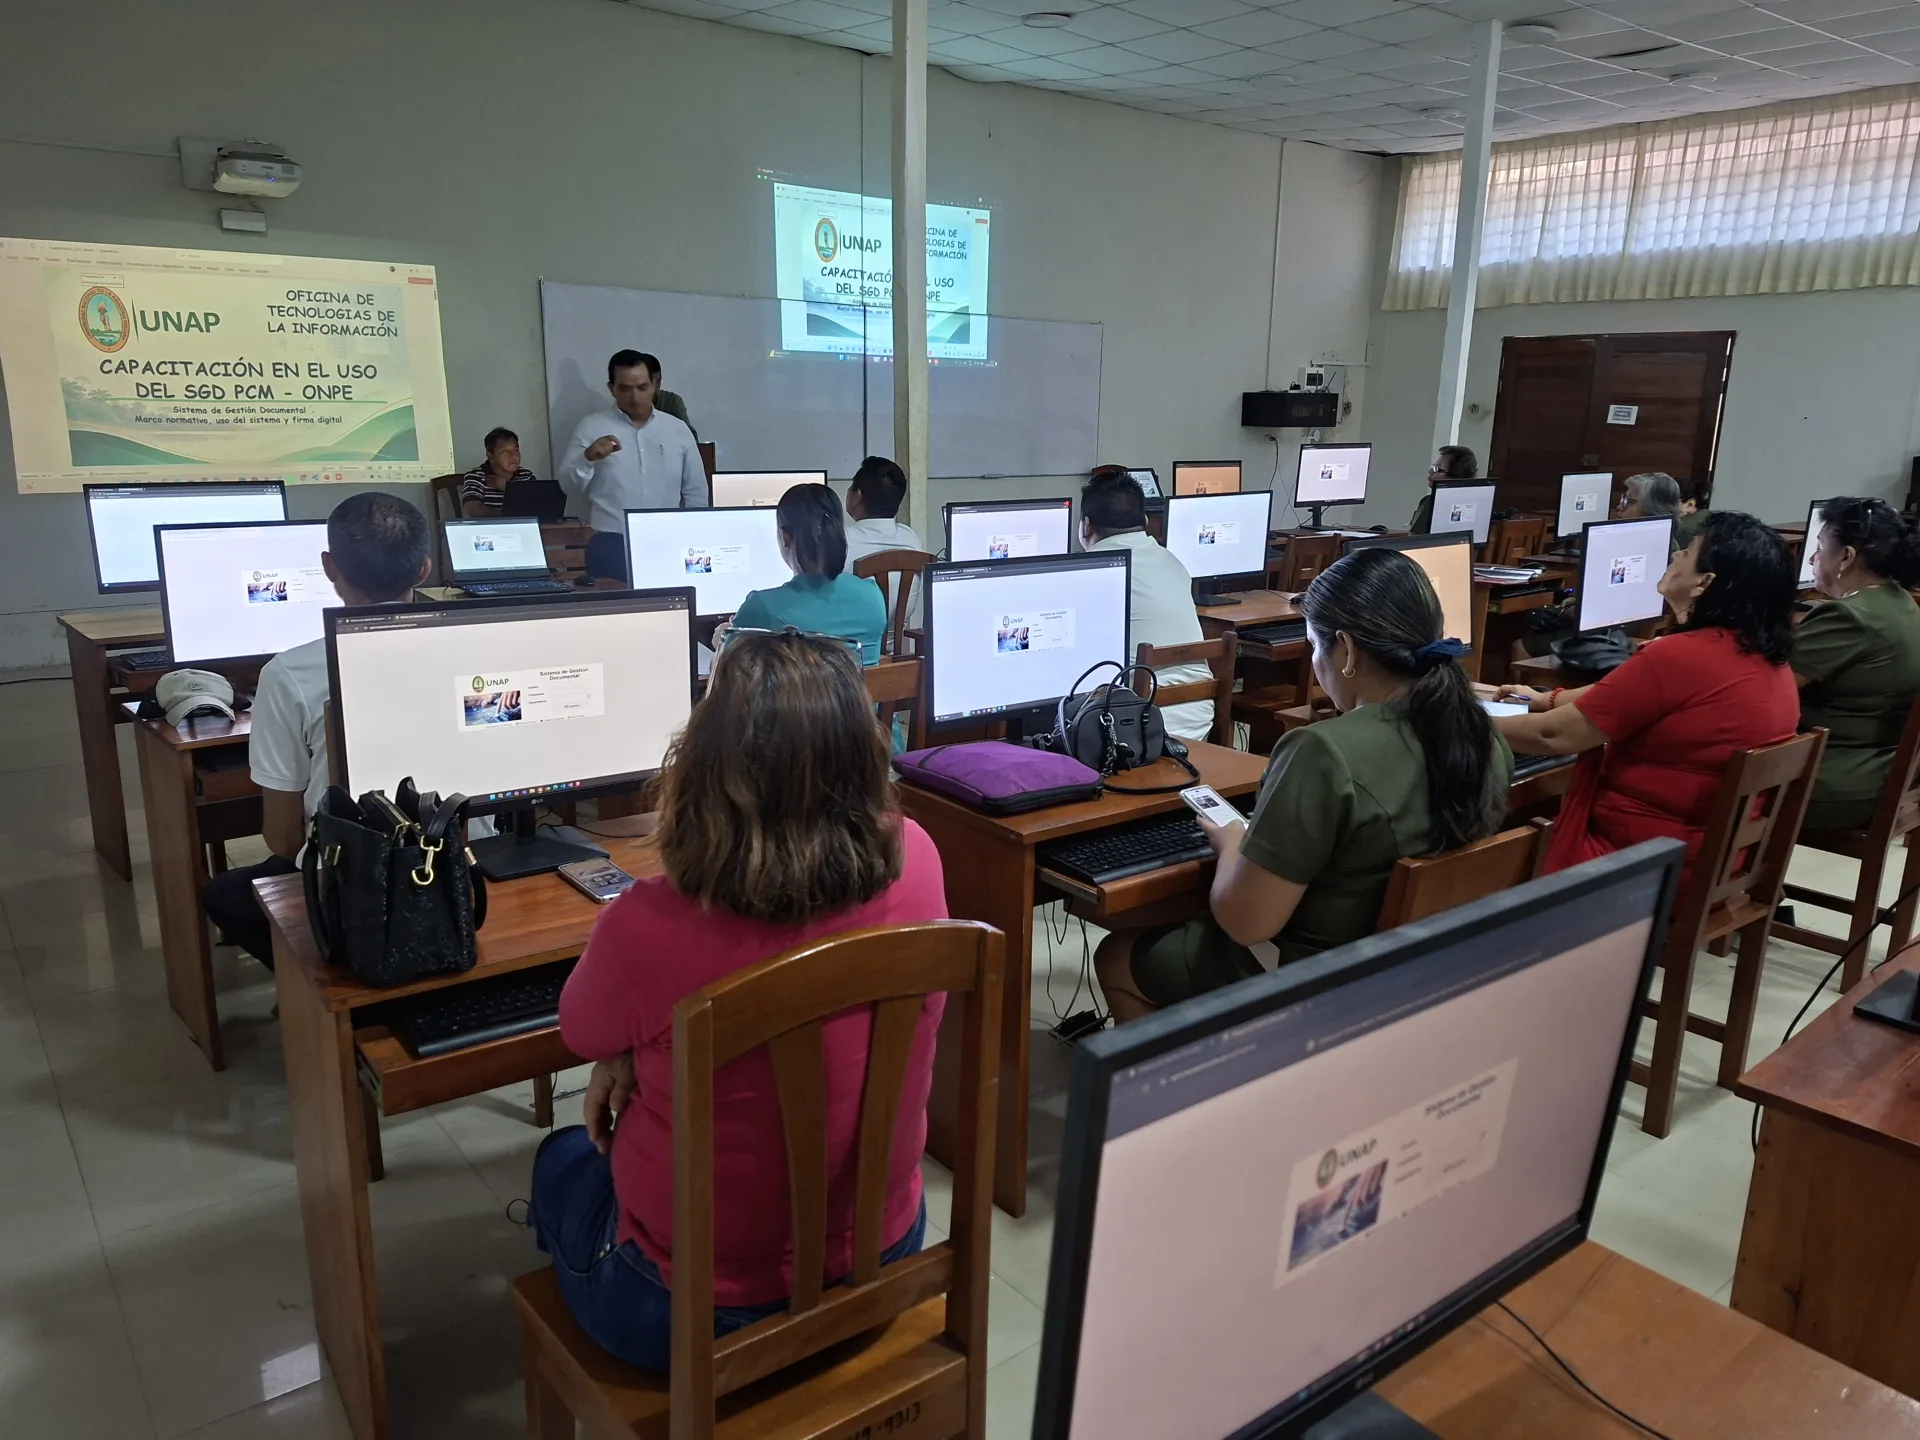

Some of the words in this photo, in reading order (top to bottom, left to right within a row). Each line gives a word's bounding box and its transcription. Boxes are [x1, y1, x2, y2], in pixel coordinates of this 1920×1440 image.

[949, 229, 958, 238] DE
[843, 234, 882, 253] UNAP
[958, 241, 967, 250] DE
[821, 266, 892, 283] CAPACITACIÓ
[934, 278, 954, 288] USO
[836, 283, 854, 294] DEL
[286, 290, 350, 304] OFICINA
[357, 294, 374, 306] DE
[140, 309, 220, 332] UNAP
[267, 305, 371, 320] TECNOLOGIAS
[377, 310, 395, 322] DE
[268, 322, 286, 333] LA
[292, 323, 398, 337] INFORMACIÓN
[100, 357, 264, 378] CAPACITACIÓN
[272, 362, 300, 378] EN
[308, 362, 330, 379] EL
[337, 364, 378, 380] USO
[135, 382, 175, 400] DEL
[184, 384, 226, 400] SGD
[235, 384, 274, 400] PCM
[302, 385, 353, 400] ONPE
[225, 406, 256, 414] Gestión
[318, 416, 342, 425] digital
[486, 678, 509, 687] UNAP
